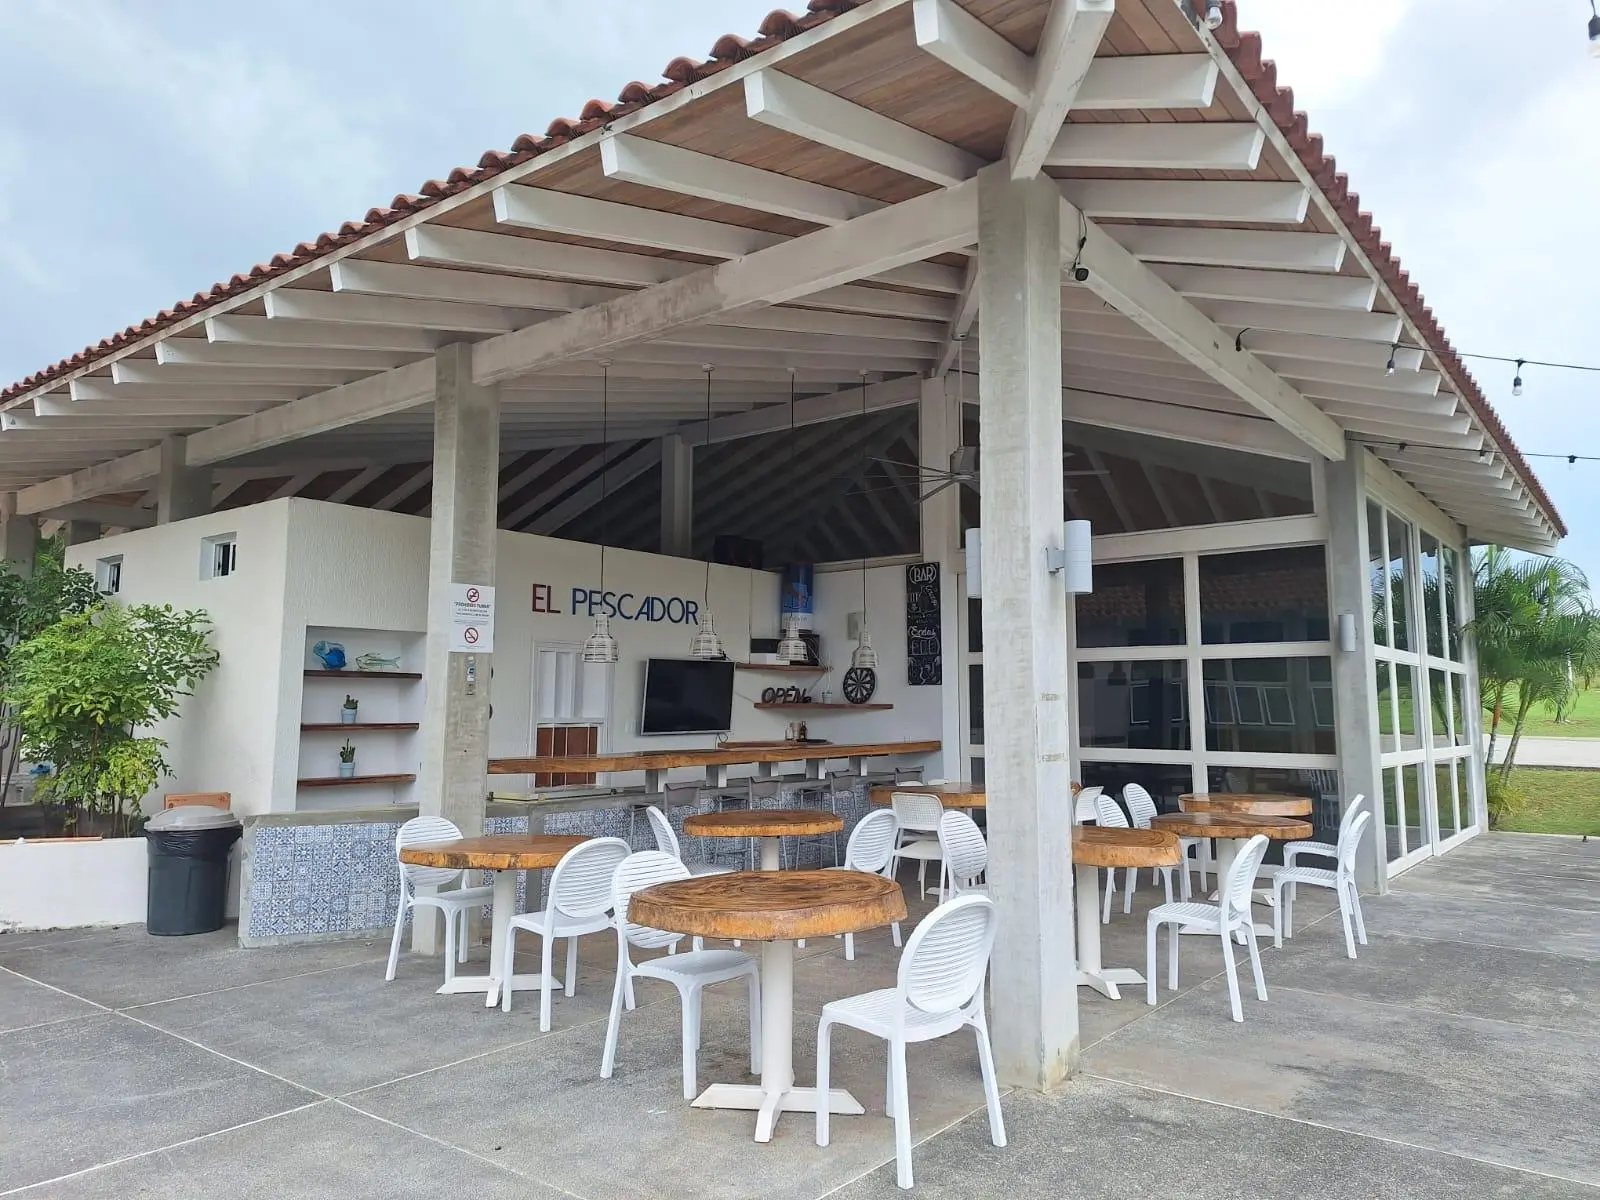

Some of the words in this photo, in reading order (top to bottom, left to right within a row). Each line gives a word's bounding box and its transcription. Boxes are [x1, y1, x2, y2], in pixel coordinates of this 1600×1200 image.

[914, 566, 934, 582] BAR
[532, 583, 561, 614] EL
[572, 587, 699, 626] PESCADOR
[761, 686, 808, 703] OPEN
